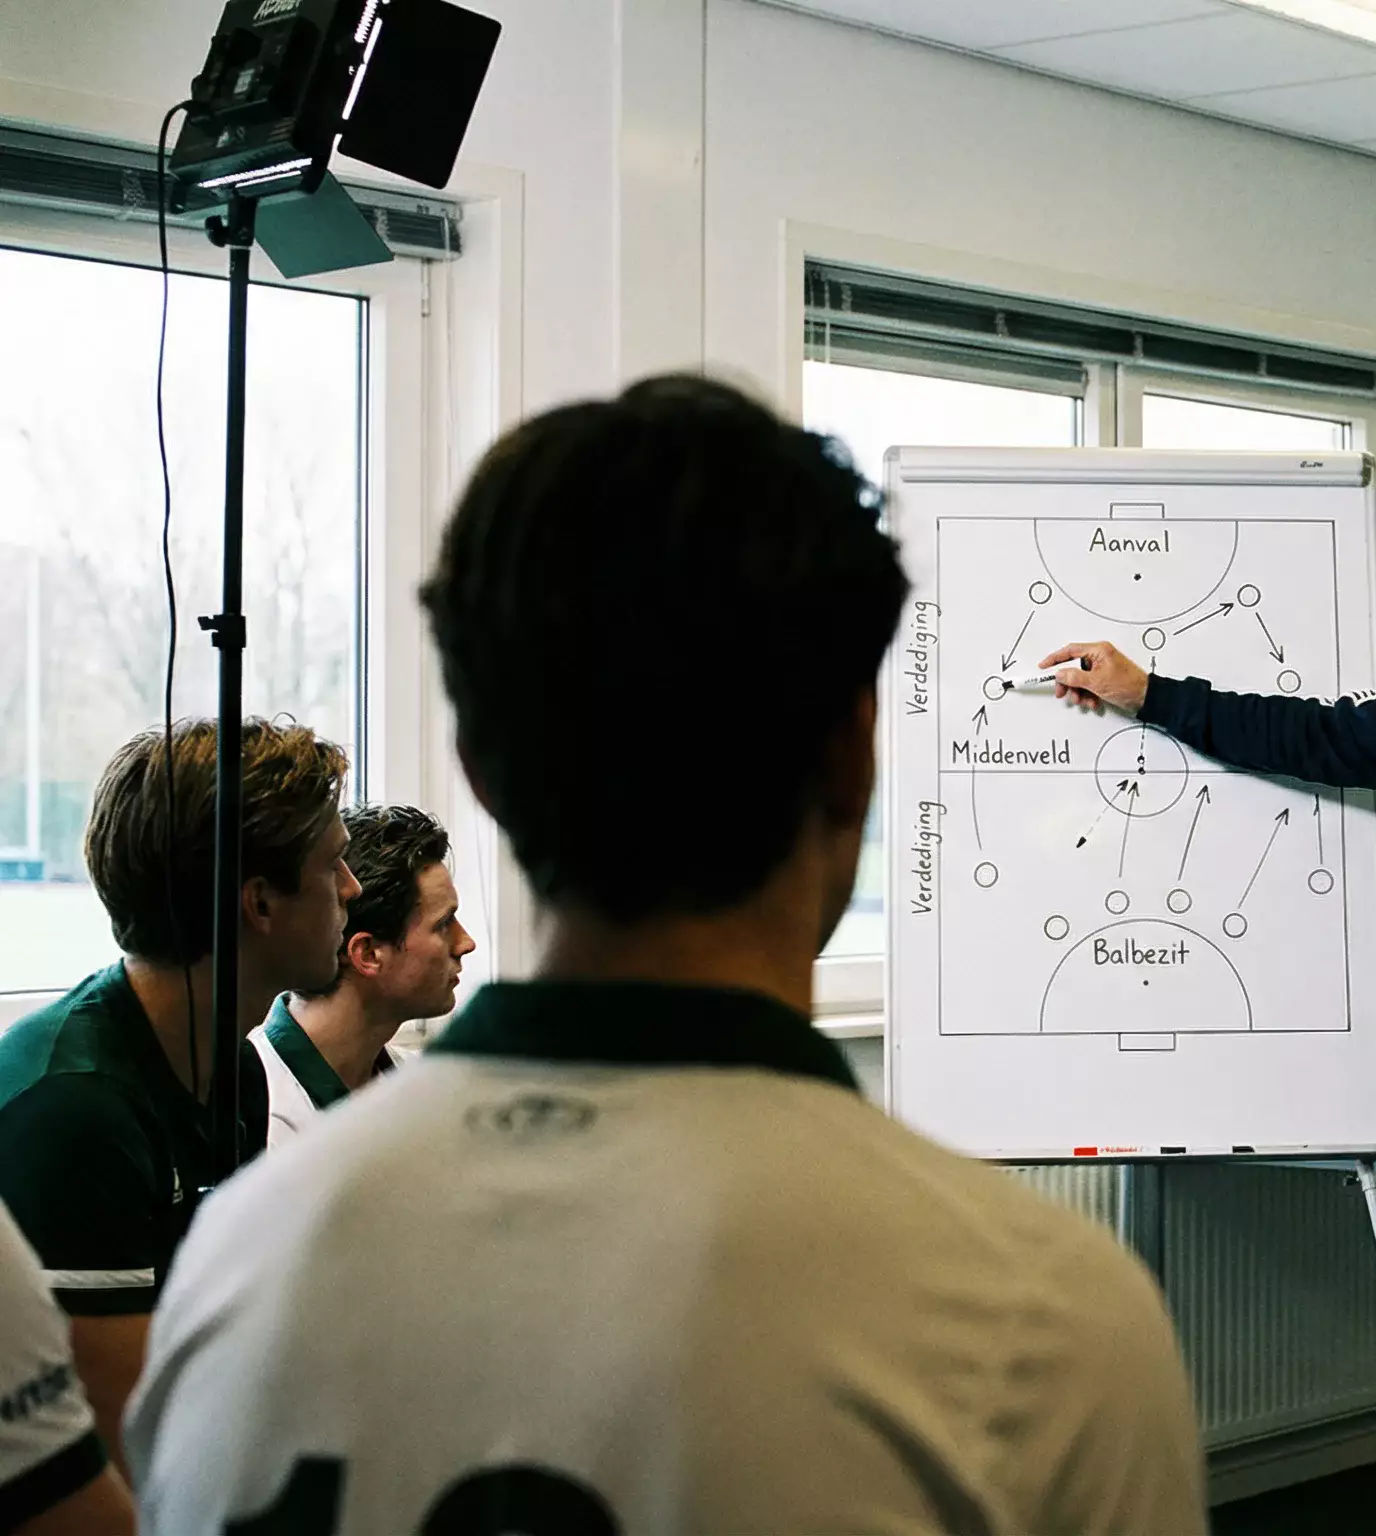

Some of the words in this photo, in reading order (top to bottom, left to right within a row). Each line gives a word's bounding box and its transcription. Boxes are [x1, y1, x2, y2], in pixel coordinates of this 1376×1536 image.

[1089, 527, 1170, 553] Aanval
[905, 599, 942, 715] Verdediging
[952, 738, 1071, 765] Middenveld
[910, 800, 948, 915] Verdediging
[1093, 937, 1190, 966] Balbezit
